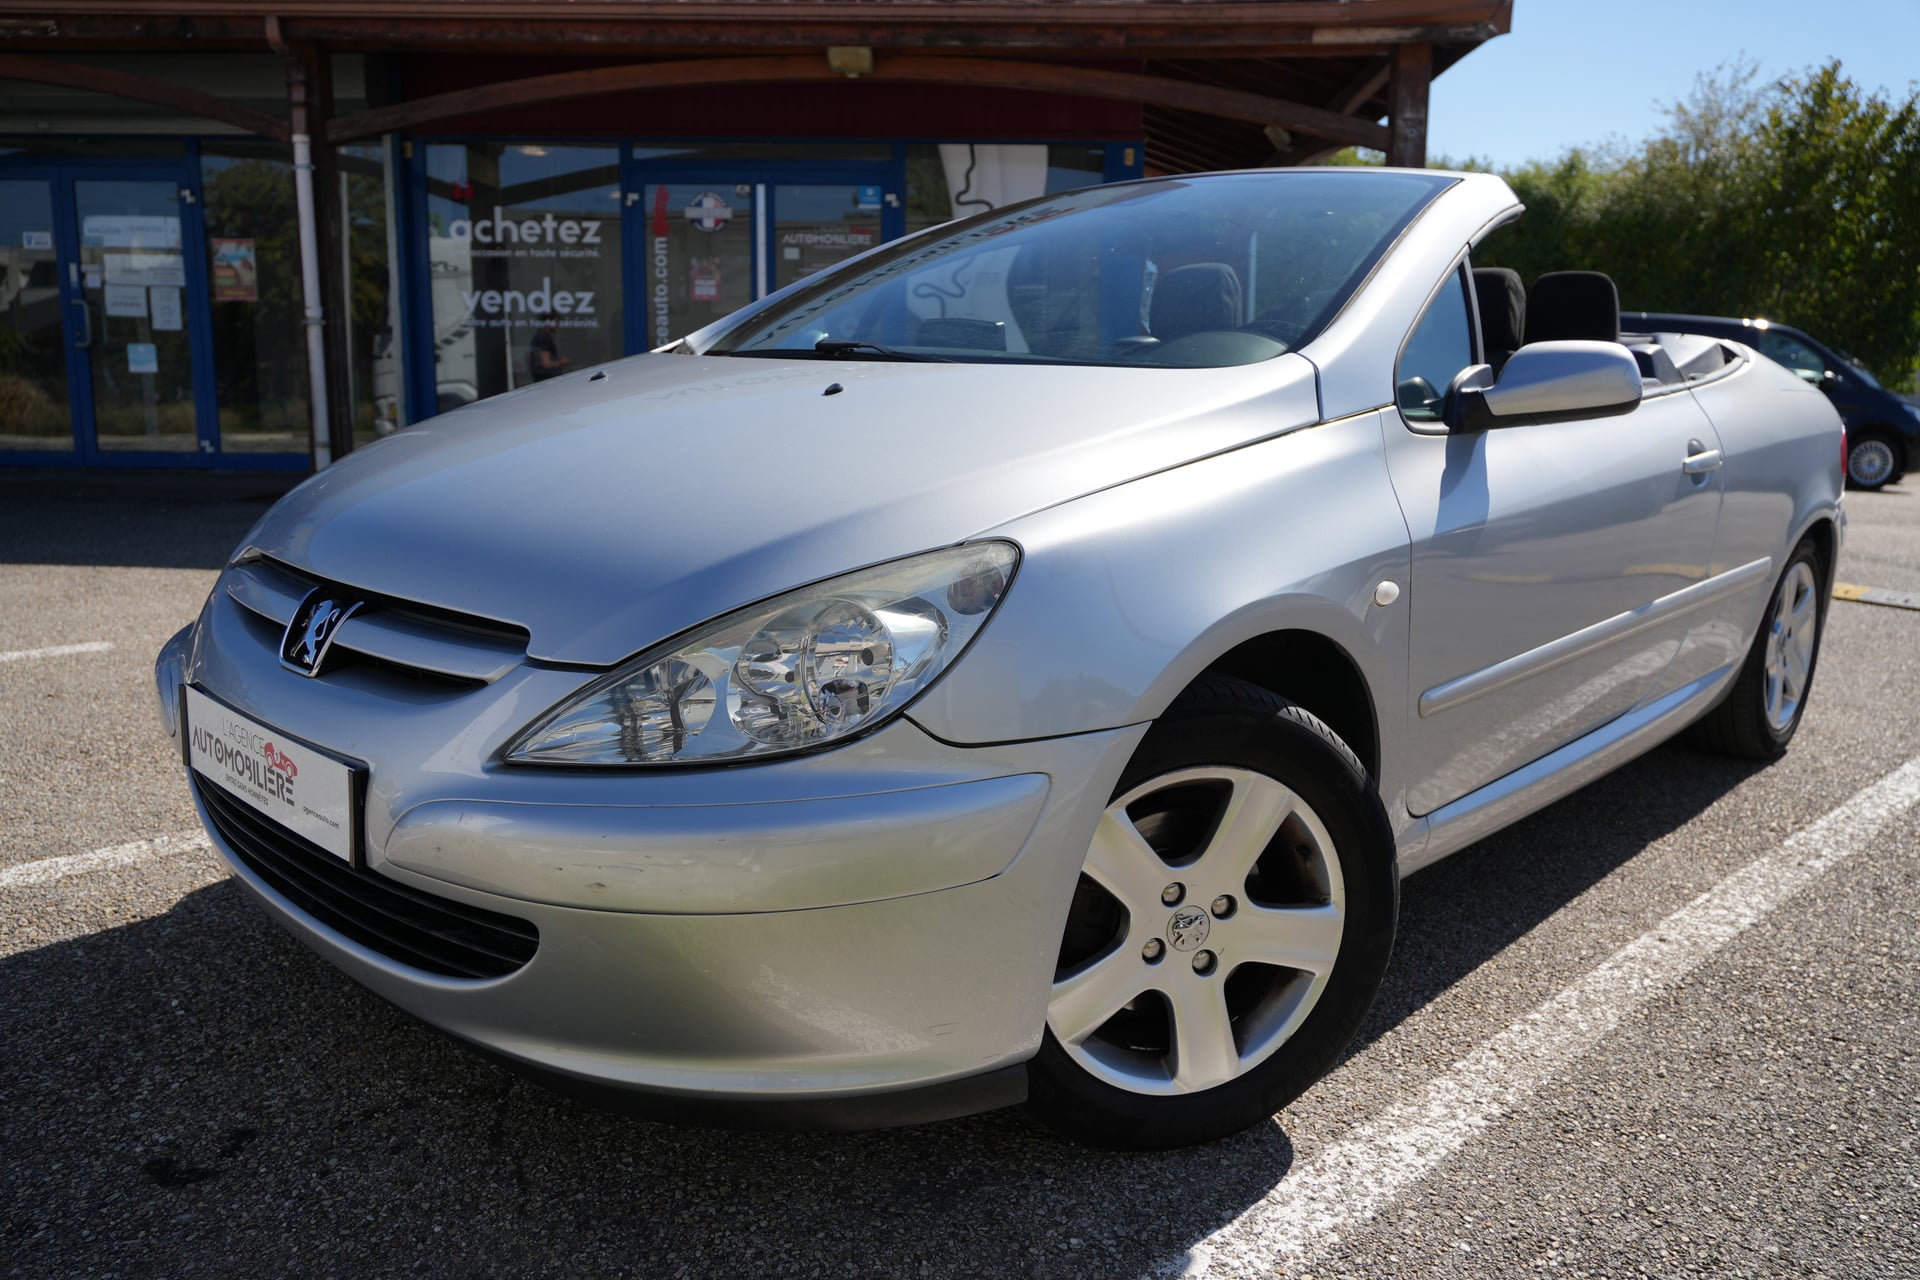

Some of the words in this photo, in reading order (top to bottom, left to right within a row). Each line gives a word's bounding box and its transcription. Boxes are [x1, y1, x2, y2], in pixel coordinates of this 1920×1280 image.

[450, 206, 602, 244] achetez
[461, 277, 595, 313] vendez
[222, 718, 265, 757] L'AGENCE
[192, 724, 295, 807] AUTOMOBILIERE
